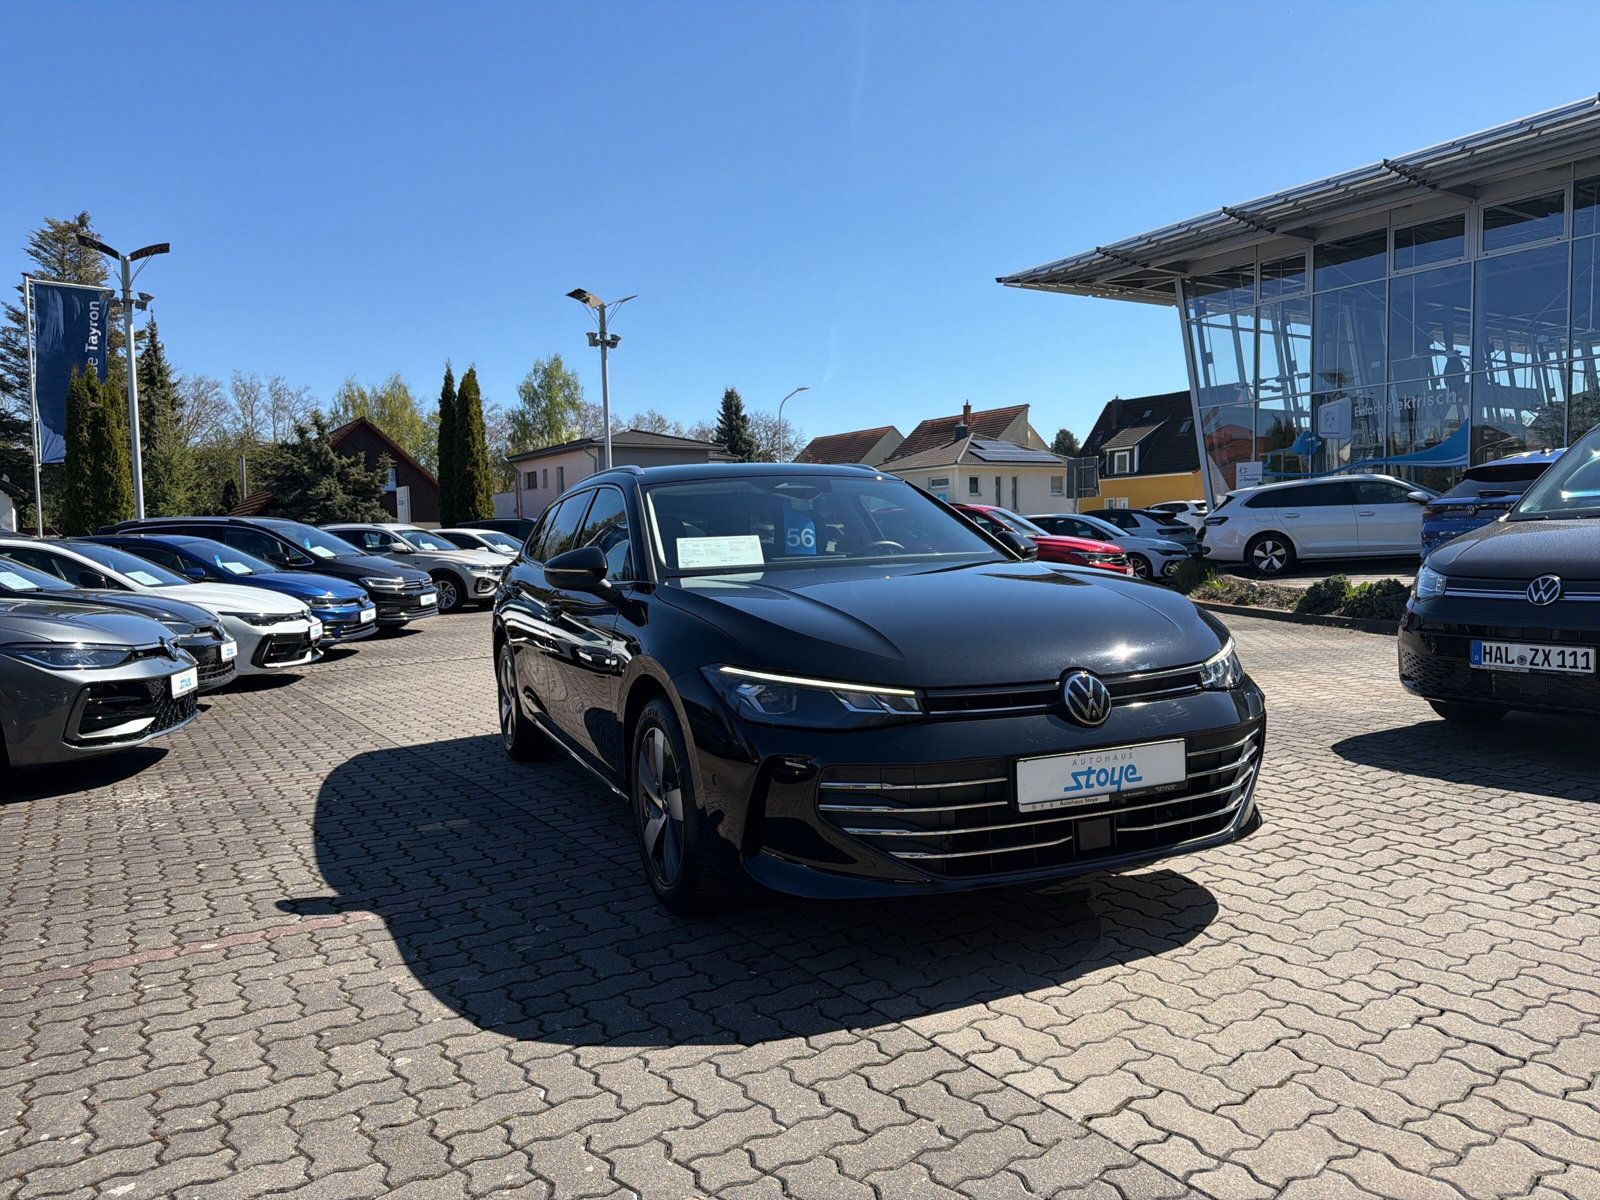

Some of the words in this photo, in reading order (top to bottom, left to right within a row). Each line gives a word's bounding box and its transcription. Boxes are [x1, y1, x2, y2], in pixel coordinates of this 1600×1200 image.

[85, 301, 101, 353] Tayron
[786, 528, 816, 548] 56
[1482, 645, 1515, 665] HAL
[1528, 648, 1552, 668] ZX
[1556, 650, 1592, 671] 111
[1072, 751, 1134, 766] AUTOHAUS
[1059, 797, 1084, 807] Autohaus
